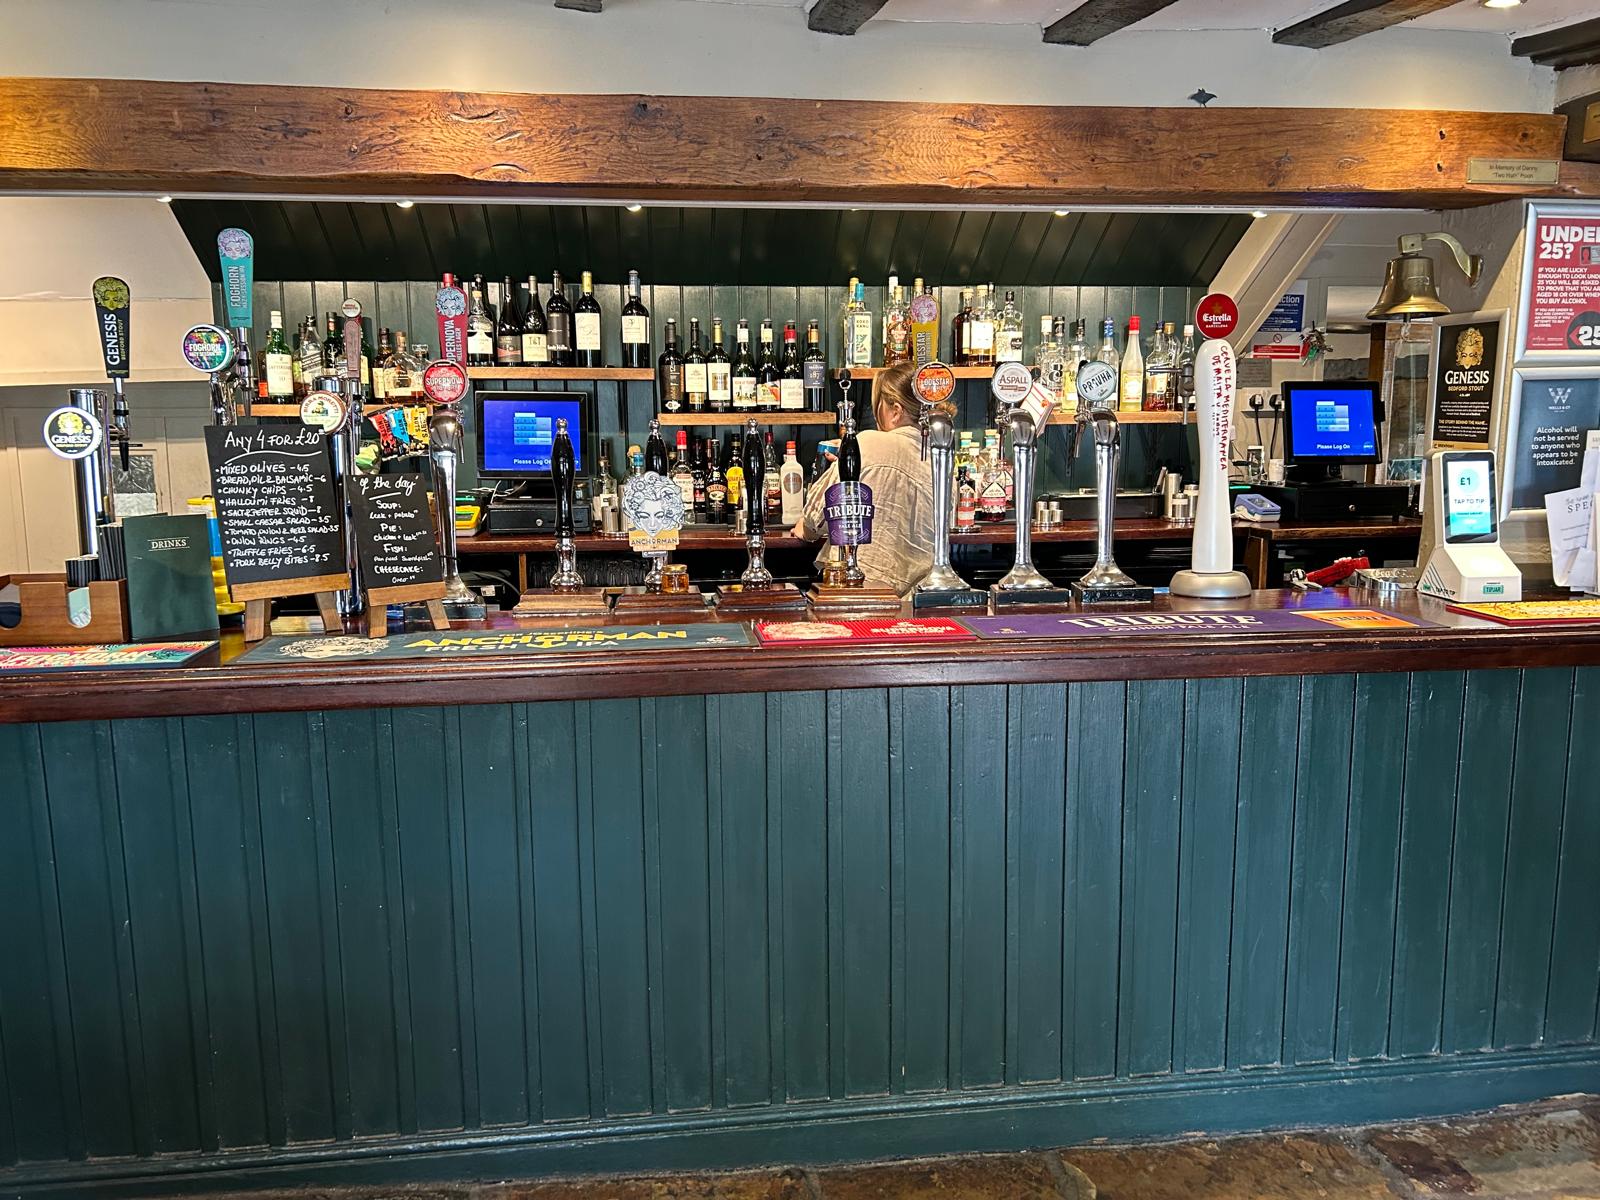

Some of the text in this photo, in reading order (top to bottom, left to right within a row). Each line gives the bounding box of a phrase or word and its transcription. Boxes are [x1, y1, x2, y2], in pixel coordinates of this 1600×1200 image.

[1539, 243, 1574, 259] 25?
[228, 266, 242, 308] FOGHORN
[1280, 295, 1300, 304] ction
[1203, 313, 1232, 322] Estrella
[103, 313, 121, 365] GENESIS
[444, 319, 457, 362] UPERNOVA
[189, 343, 221, 352] FOGHORN
[425, 376, 464, 386] SUPERNOVA
[999, 374, 1027, 385] ASPALL
[1082, 370, 1113, 394] PRAVHA
[1444, 370, 1490, 385] GENESIS
[50, 434, 92, 444] GENESIS
[257, 430, 264, 449] 4
[267, 435, 293, 446] FOR
[1540, 443, 1564, 451] anyone
[1532, 451, 1559, 459] appears
[220, 462, 248, 474] MIXED
[250, 461, 286, 473] OLIVES
[373, 476, 391, 489] the
[1460, 477, 1472, 486] £1
[223, 487, 258, 499] CHUNKY
[261, 485, 287, 495] CHIPS
[226, 497, 268, 506] HALLOUMI
[270, 495, 296, 505] FRIES
[827, 504, 871, 518] TRIBUTE
[286, 516, 310, 524] SALAD
[152, 539, 187, 549] DRINKS
[231, 537, 256, 545] ONION
[259, 536, 285, 545] RINGS
[631, 537, 677, 546] ANCHORMAN
[232, 548, 266, 557] TRUFFLE
[268, 546, 293, 556] FRIES
[234, 558, 256, 567] PORK
[258, 558, 282, 570] BELLY
[284, 555, 308, 565] BITES
[1058, 614, 1264, 628] TRIBUTE
[403, 630, 688, 649] ANCHORMAN
[425, 643, 518, 652] FRESH
